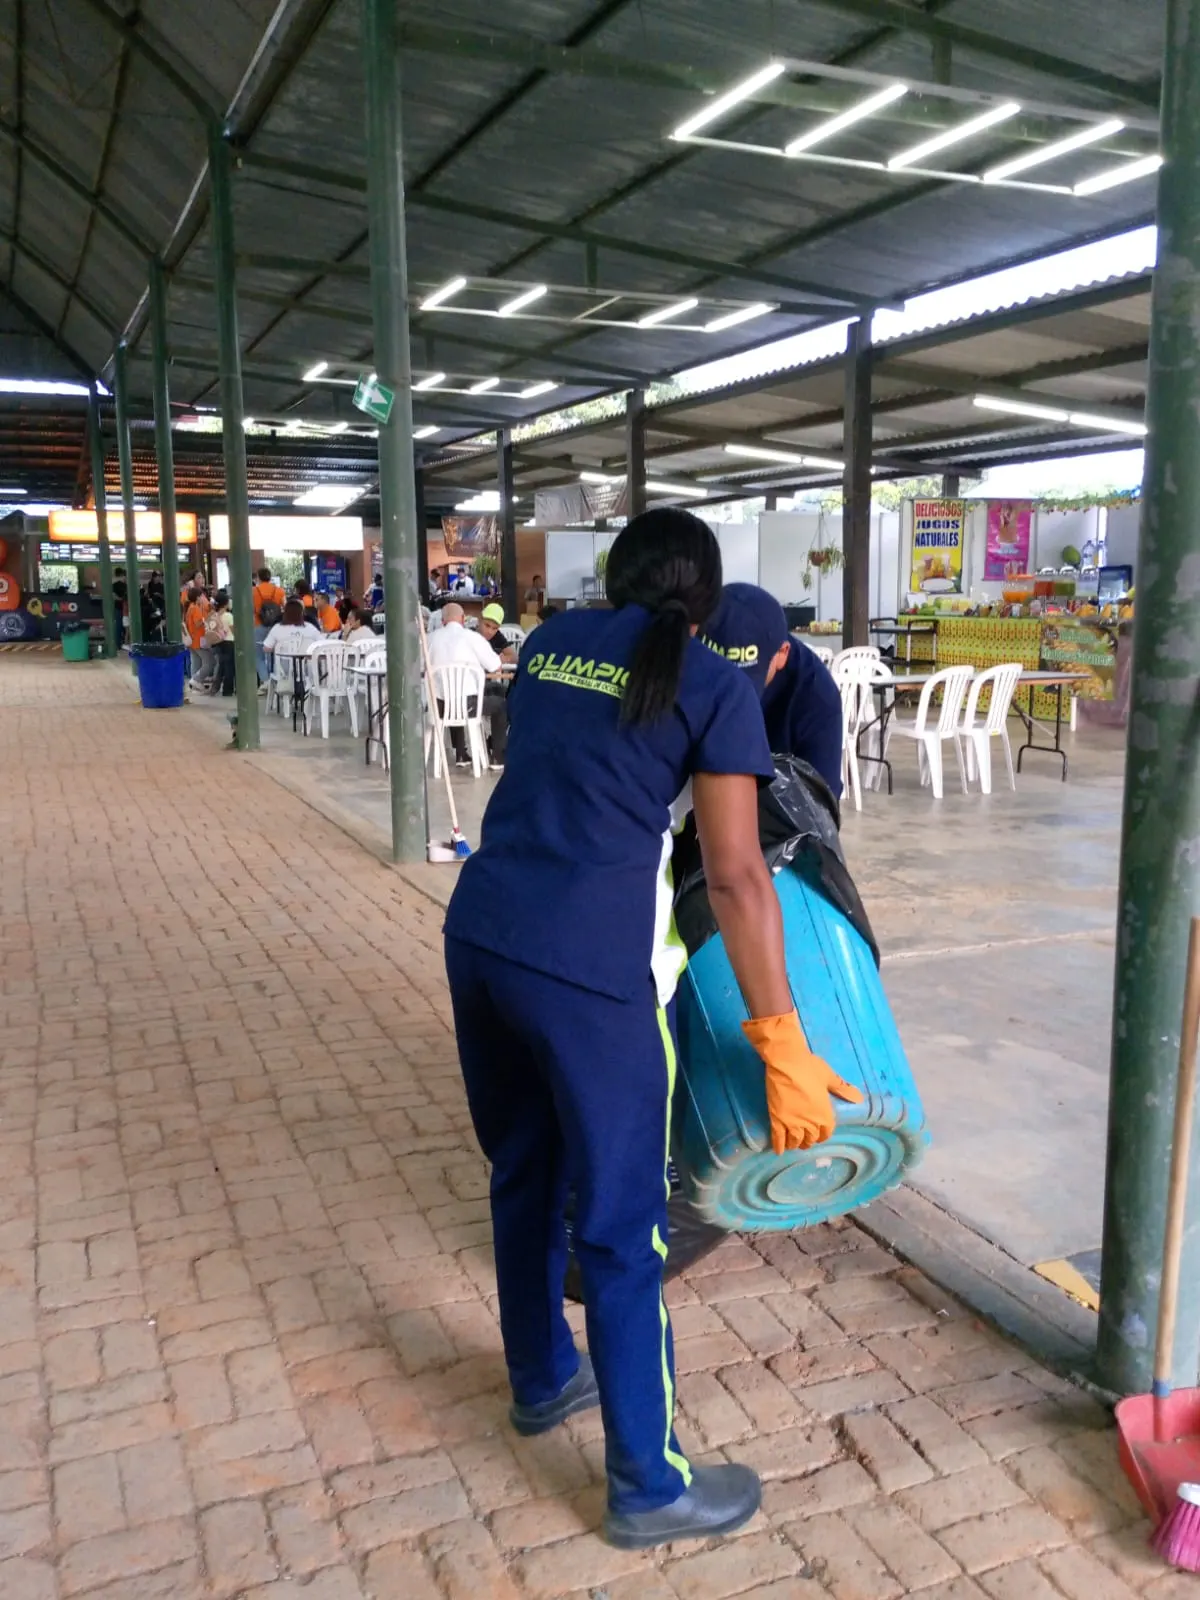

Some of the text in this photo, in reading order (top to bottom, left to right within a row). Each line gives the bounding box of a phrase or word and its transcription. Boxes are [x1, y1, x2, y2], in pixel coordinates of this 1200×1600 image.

[915, 503, 962, 517] DELICIOSOS
[916, 520, 960, 529] JUGOS
[915, 532, 958, 547] NATURALES
